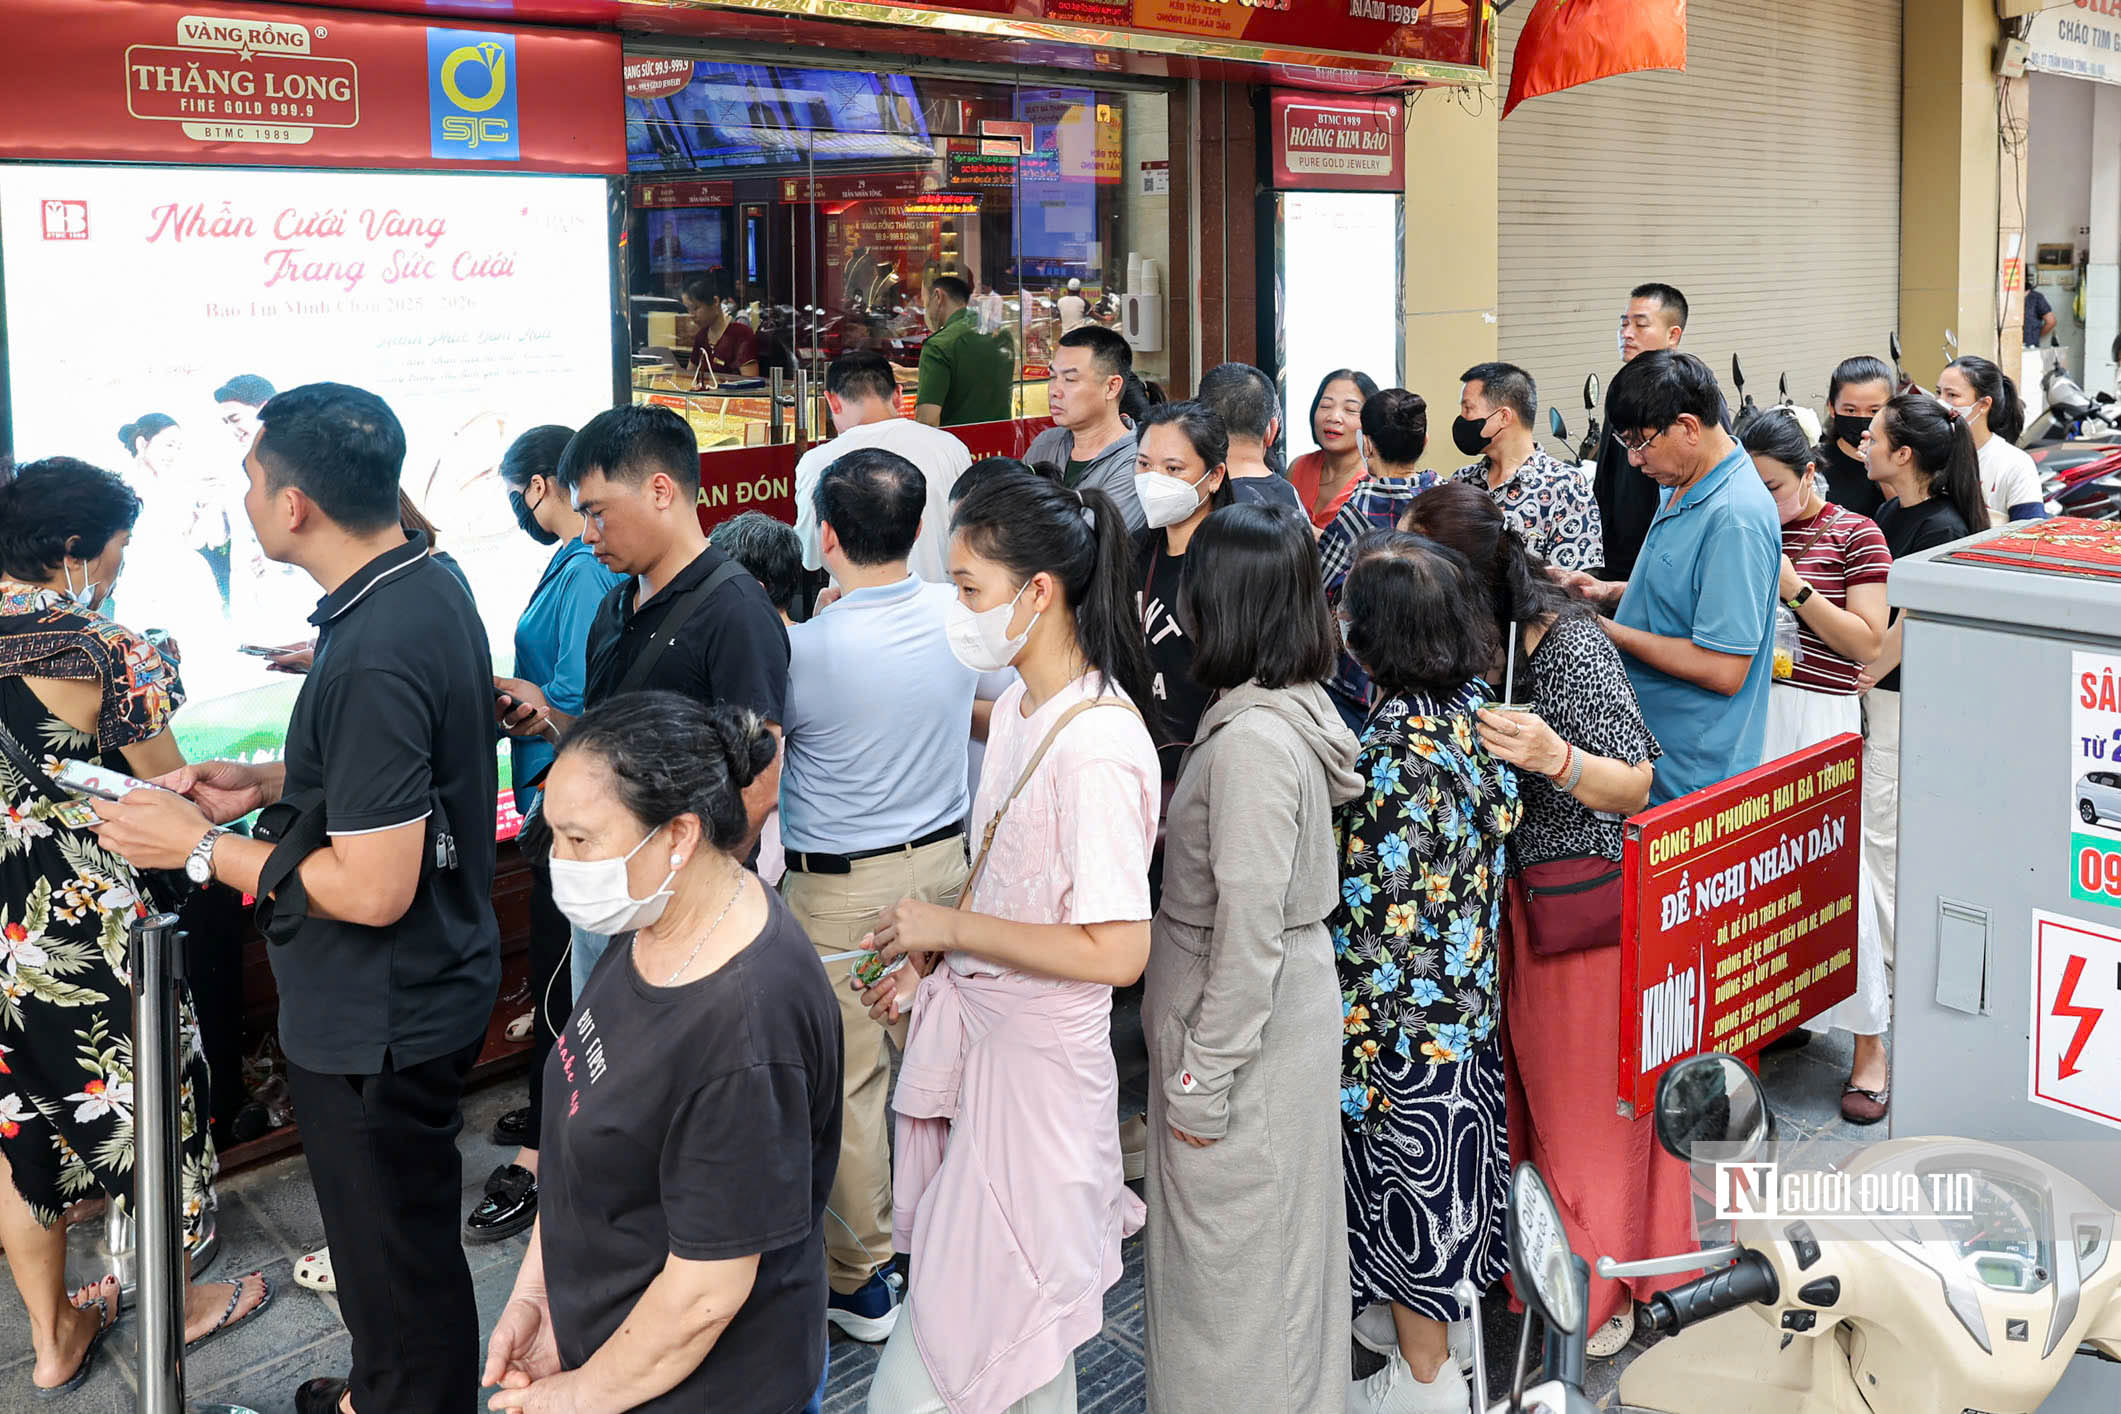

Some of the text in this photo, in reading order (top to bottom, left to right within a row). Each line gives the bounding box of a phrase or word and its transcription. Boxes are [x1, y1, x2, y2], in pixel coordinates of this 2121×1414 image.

[1387, 4, 1419, 25] 1989
[185, 22, 243, 43] VÀNG
[248, 24, 304, 47] RỒNG
[2058, 19, 2088, 45] CHÁO
[2092, 27, 2111, 50] TIM
[132, 61, 351, 101] THĂNG LONG
[180, 98, 314, 117] FINE GOLD 999.9
[1317, 114, 1361, 127] BTMC 1989
[205, 127, 290, 141] BTMC 1989
[442, 115, 509, 149] SJC
[1290, 122, 1388, 151] HOÀNG KIM BẢO
[1299, 156, 1380, 170] PURE GOLD JEWELRY
[146, 200, 256, 243] Nhẫn
[273, 206, 348, 241] Cưới
[263, 247, 517, 293] Trang Sức Cưới
[735, 473, 789, 504] ĐÓN
[2080, 666, 2121, 714] SÂ
[2081, 734, 2107, 760] TỪ
[1650, 757, 1856, 866] CÔNG AN PHƯỜNG HAI BÀ TRƯNG
[1660, 813, 1846, 932] ĐỀ NGHỊ NHÂN DÂN
[1760, 900, 1777, 926] TRÊN
[1716, 951, 1742, 981] KHÔNG
[1753, 940, 1763, 961] XE
[1763, 930, 1780, 957] MÁY
[1780, 922, 1797, 948] TRÊN
[1820, 901, 1836, 927] DƯỚI
[1836, 894, 1852, 917] LÒNG
[1741, 967, 1754, 991] SAI
[1755, 961, 1770, 986] QUY
[1714, 1009, 1740, 1039] KHÔNG
[1741, 997, 1755, 1025] XẾP
[1755, 990, 1774, 1017] HÀNG
[1794, 967, 1812, 994] DƯỚI
[1812, 960, 1829, 984] LÒNG
[1641, 962, 1696, 1075] KHÔNG
[1728, 1030, 1745, 1055] CẢN
[1745, 1018, 1760, 1046] TRỞ
[1760, 1012, 1777, 1037] GIAO
[1778, 998, 1801, 1026] THÔNG
[585, 1036, 608, 1085] FIRST
